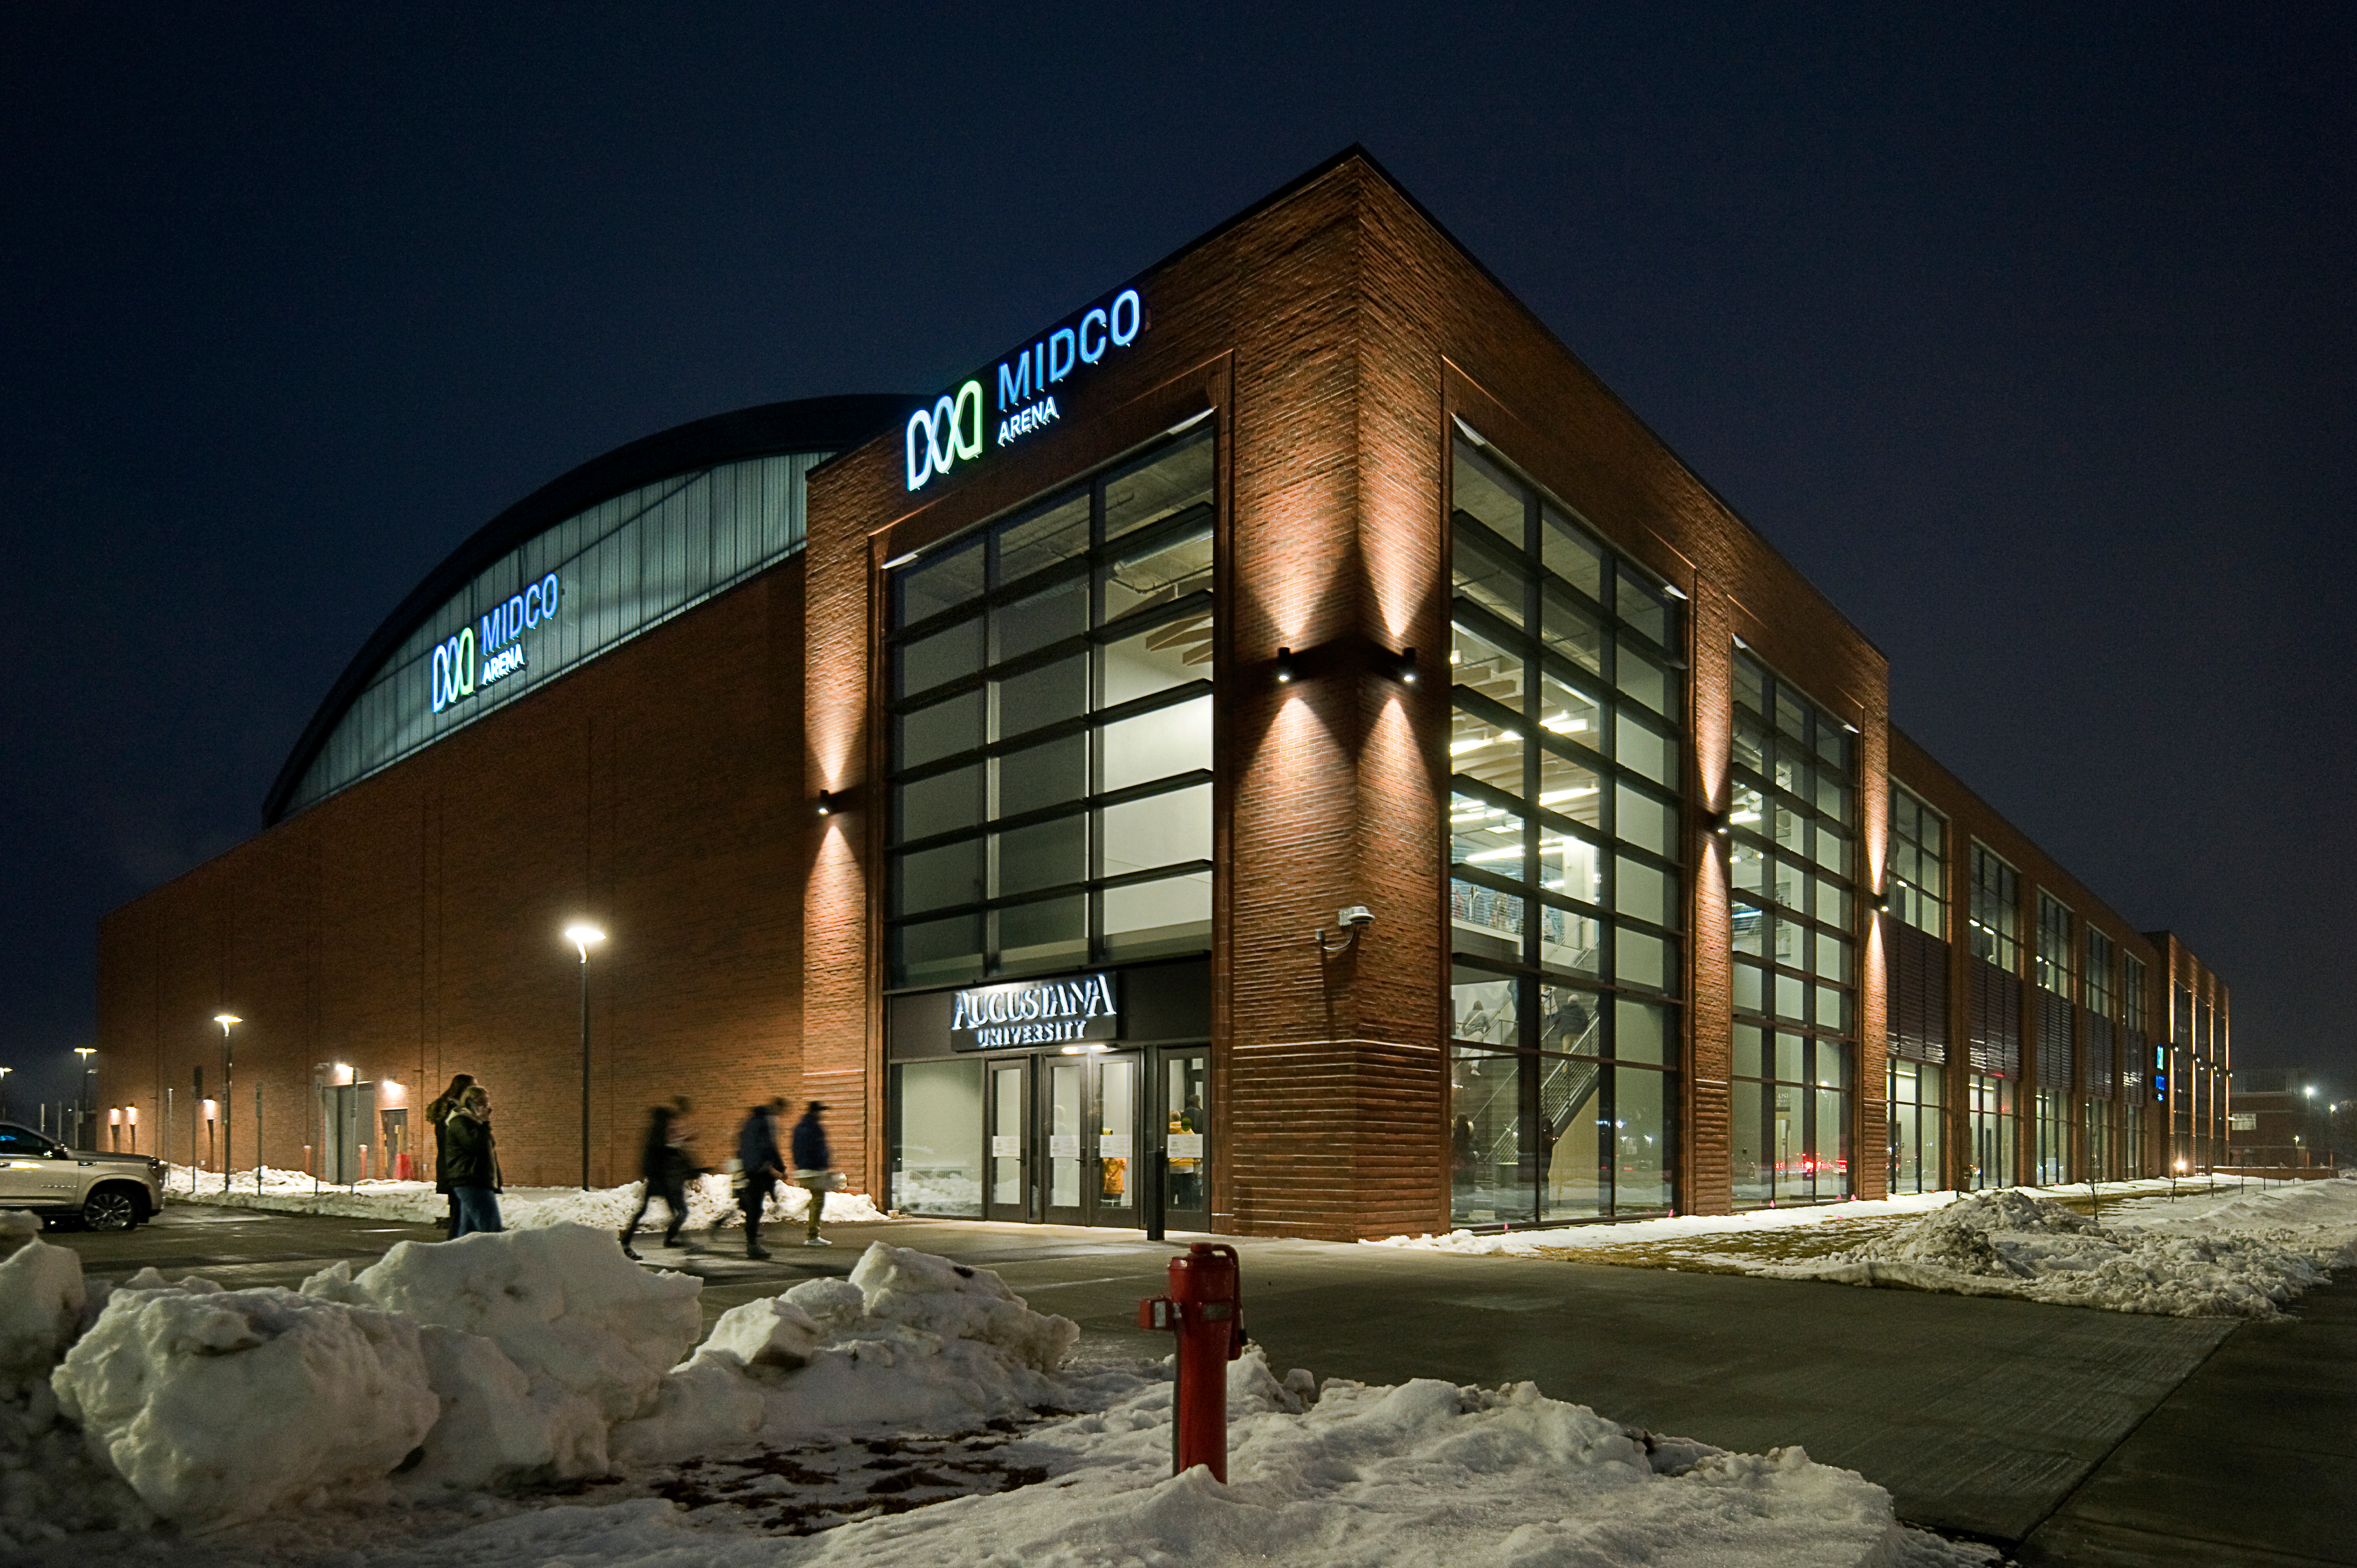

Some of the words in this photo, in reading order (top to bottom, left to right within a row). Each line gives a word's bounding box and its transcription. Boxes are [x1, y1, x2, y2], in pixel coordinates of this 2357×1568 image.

[999, 288, 1140, 411] MIDCO
[998, 396, 1058, 446] ARENA
[482, 572, 558, 656] MIDCO
[481, 643, 524, 685] ARENA
[951, 974, 1117, 1030] AUGUSTANA
[977, 1021, 1087, 1047] UNIVERSITY
